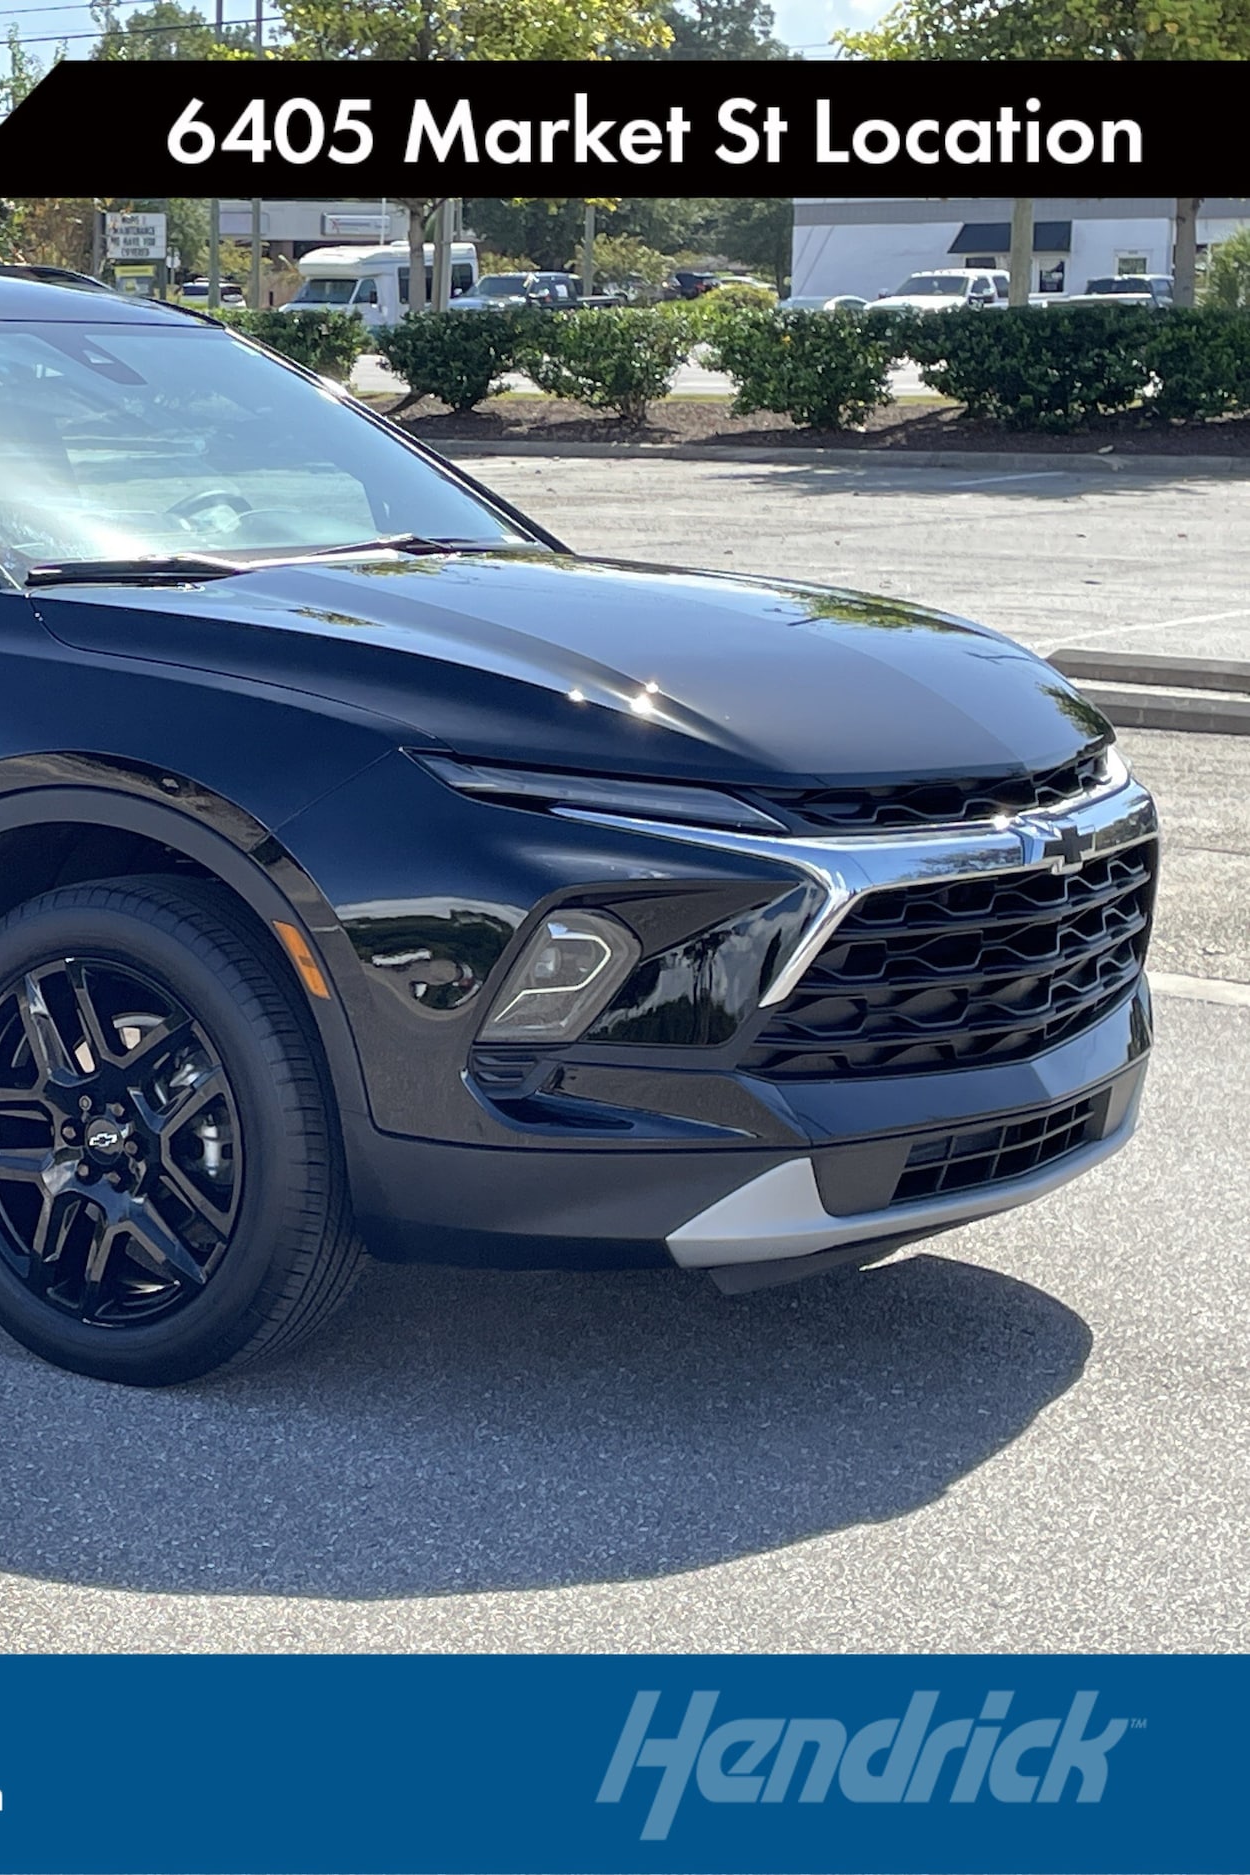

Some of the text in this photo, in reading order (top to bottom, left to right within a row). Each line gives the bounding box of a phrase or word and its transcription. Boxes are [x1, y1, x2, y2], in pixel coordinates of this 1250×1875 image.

[123, 236, 141, 247] HAVE
[143, 236, 156, 247] YOU
[121, 247, 150, 257] COVERED
